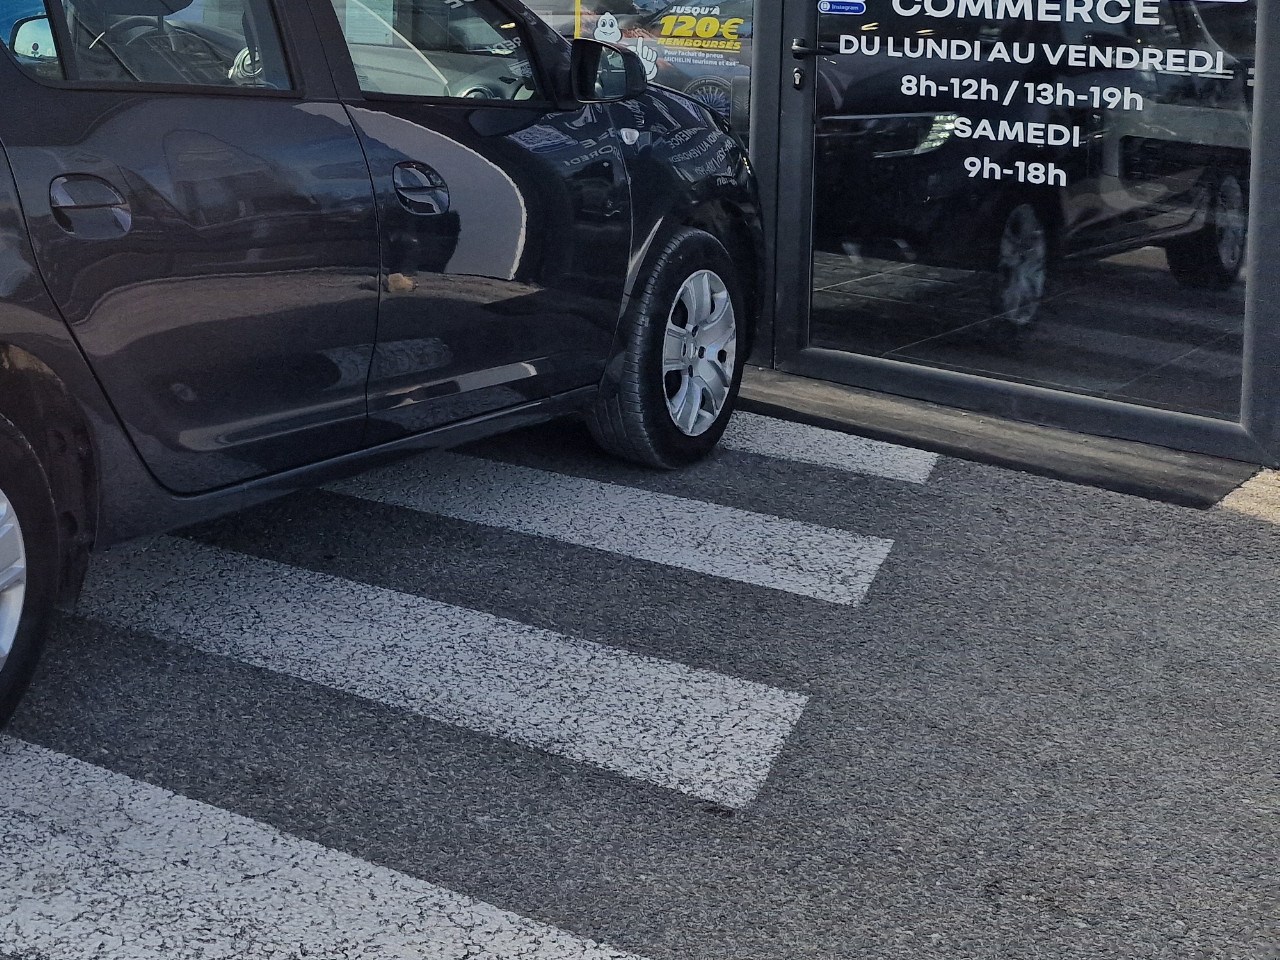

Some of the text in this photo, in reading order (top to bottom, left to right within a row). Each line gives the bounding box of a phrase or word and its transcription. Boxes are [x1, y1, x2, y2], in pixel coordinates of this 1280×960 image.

[669, 6, 720, 16] JUSQU'À
[660, 15, 744, 40] 120€
[657, 38, 741, 50] REMBOURSÉS
[838, 35, 1224, 74] DU LUNDI AU VENDREDI
[664, 56, 691, 64] MICHELIN
[692, 58, 718, 66] tourisme
[900, 75, 1144, 111] 8h-12h / 13h-19h
[953, 117, 1081, 148] SAMEDI
[963, 157, 1067, 187] 9h-18h
